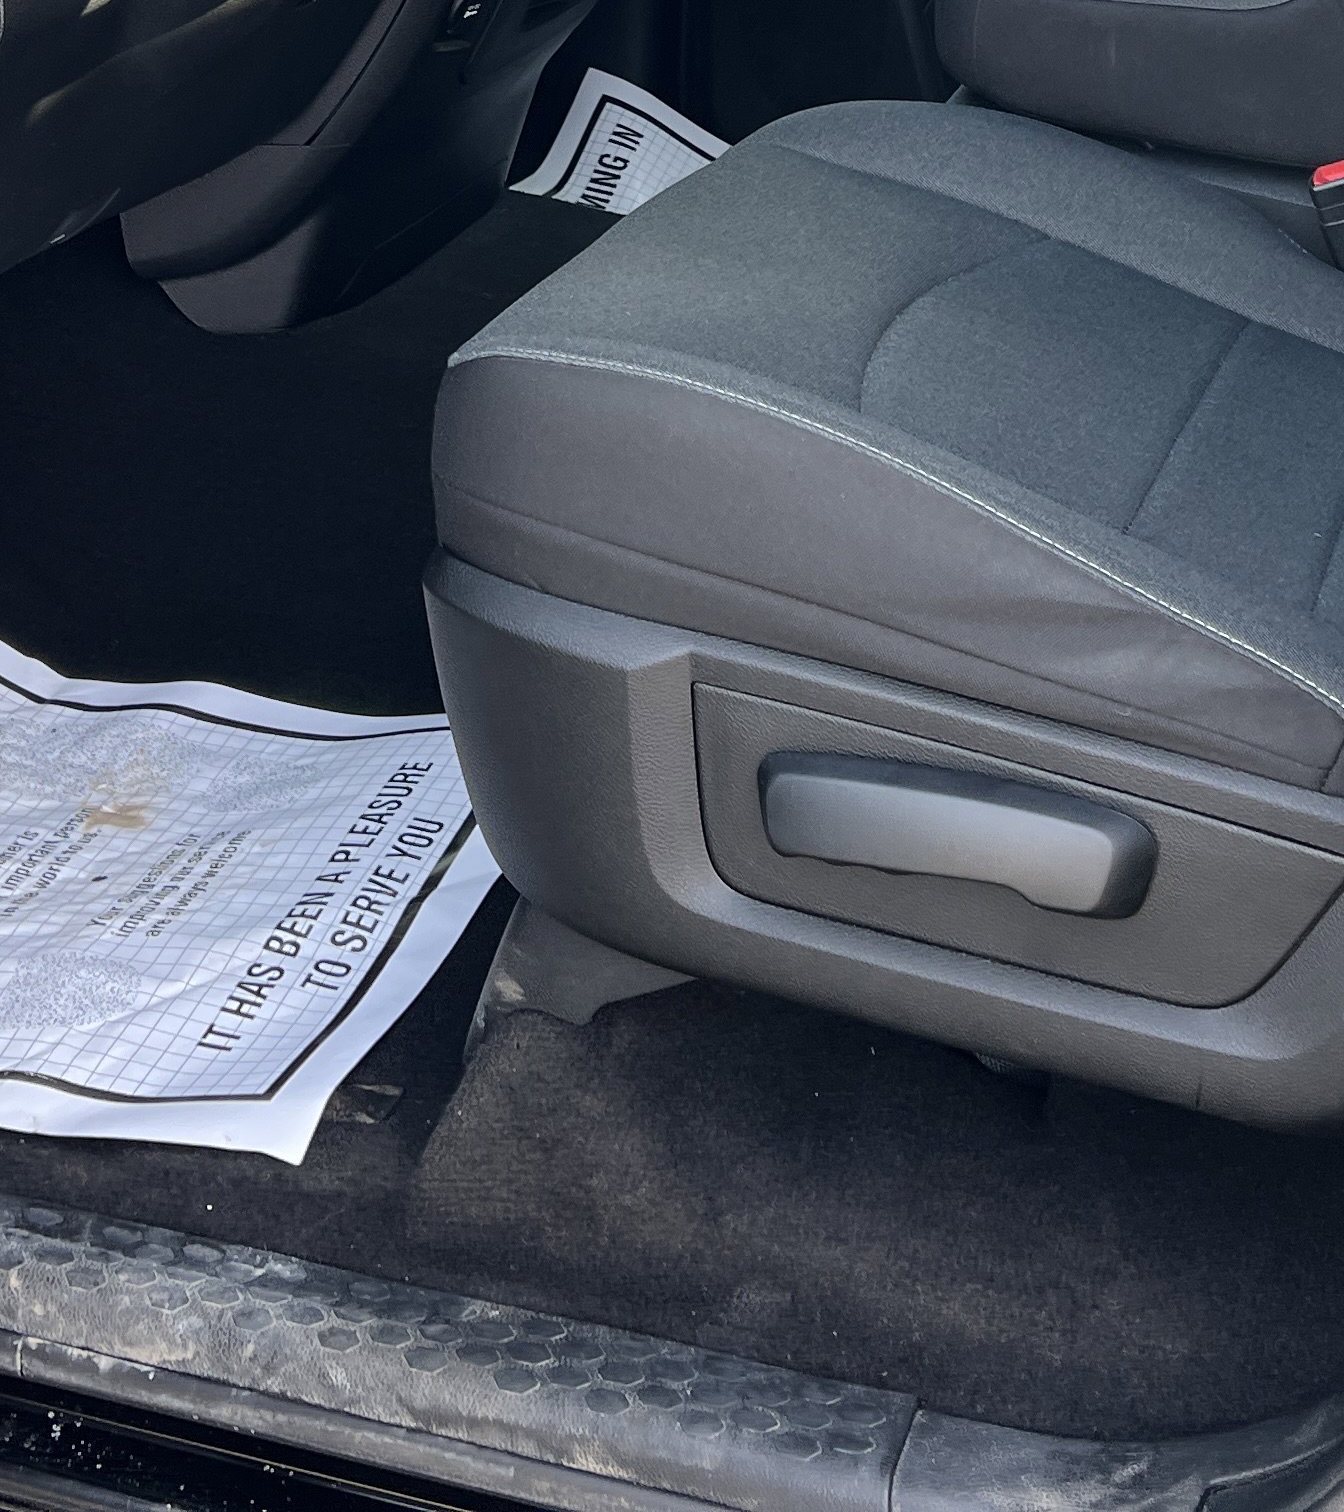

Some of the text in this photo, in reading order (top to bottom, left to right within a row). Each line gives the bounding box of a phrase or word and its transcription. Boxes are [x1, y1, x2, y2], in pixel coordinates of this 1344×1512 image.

[608, 123, 644, 152] IN
[53, 807, 95, 841] person
[33, 853, 70, 890] world
[61, 844, 83, 858] to
[87, 905, 124, 927] Your
[175, 833, 201, 847] for
[111, 884, 180, 938] improving
[170, 866, 194, 882] our
[146, 917, 172, 938] are
[165, 879, 209, 917] always
[196, 761, 434, 1052] IT HAS BEEN A PLEASURE
[300, 817, 444, 991] TO SERVE YOU
